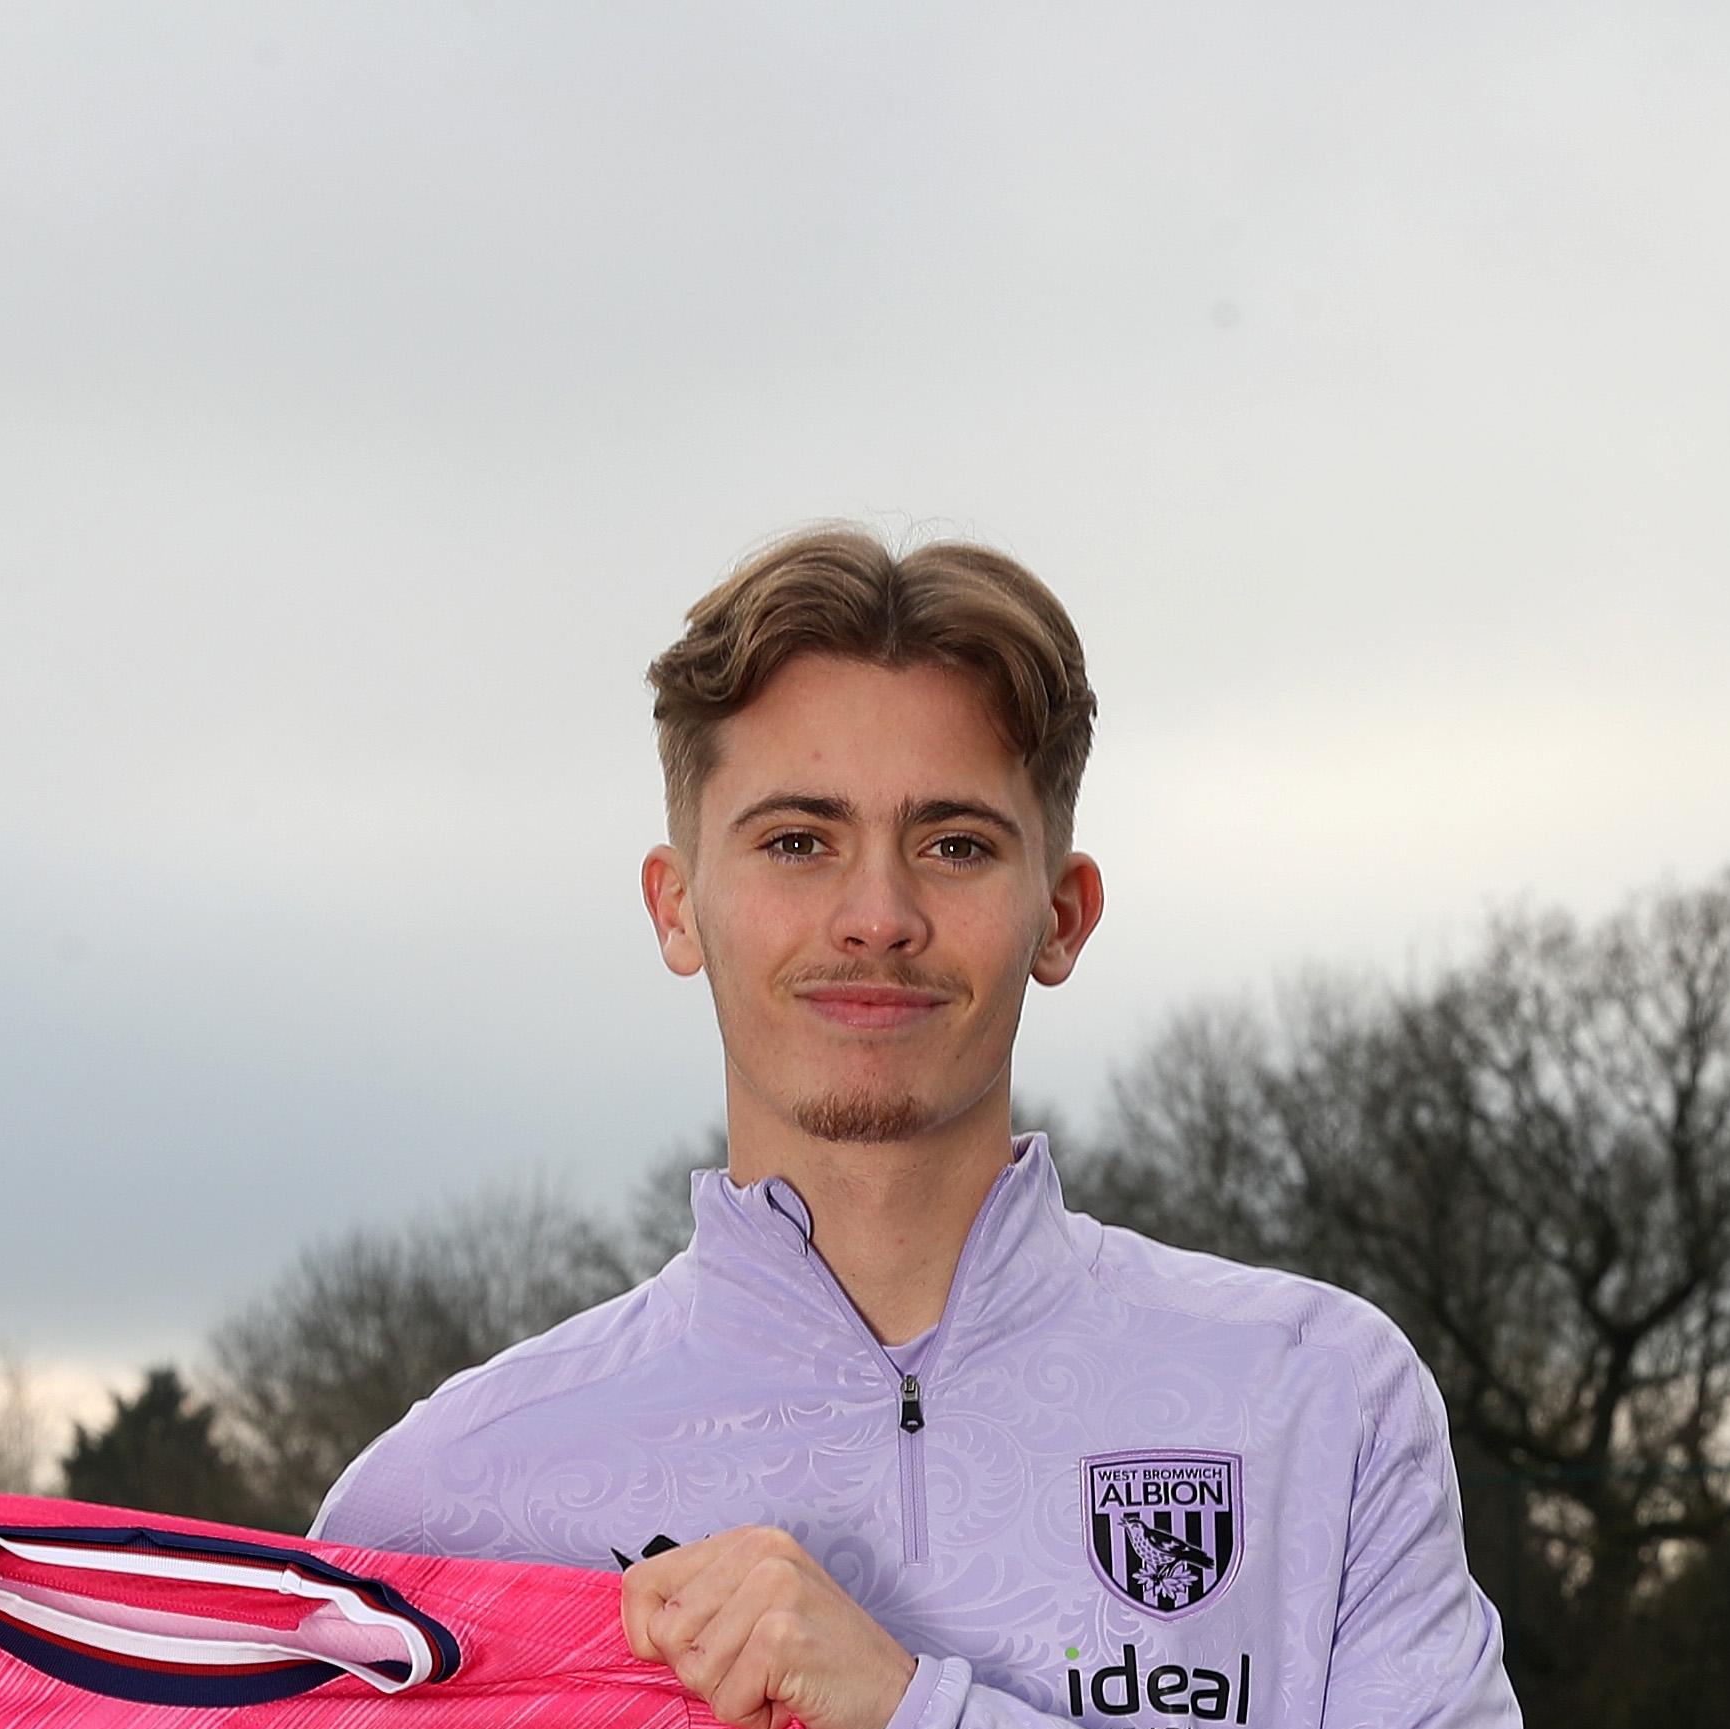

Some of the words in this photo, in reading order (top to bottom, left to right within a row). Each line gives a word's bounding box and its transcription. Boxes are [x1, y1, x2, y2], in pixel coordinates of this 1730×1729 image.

[1098, 1469, 1138, 1482] WEST
[1143, 1468, 1222, 1481] BROMWICH
[1099, 1480, 1223, 1508] ALBION
[1065, 1643, 1250, 1725] ideal
